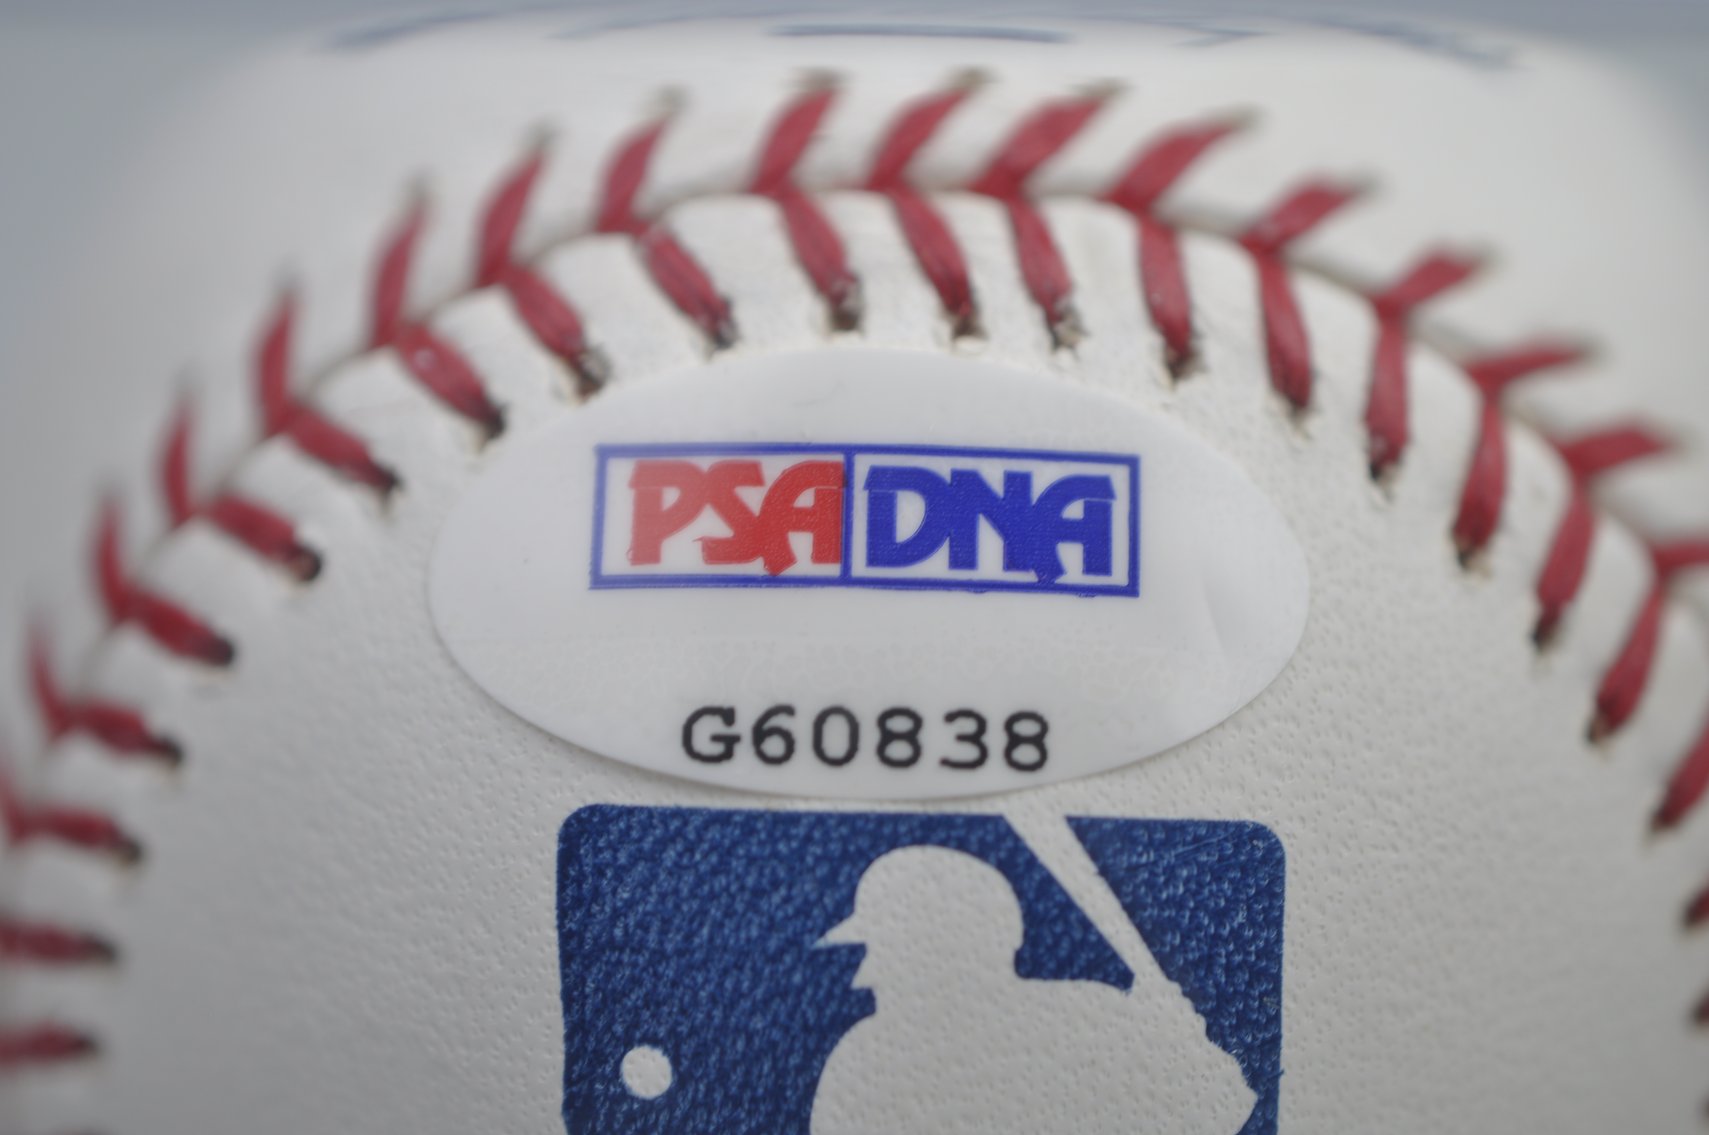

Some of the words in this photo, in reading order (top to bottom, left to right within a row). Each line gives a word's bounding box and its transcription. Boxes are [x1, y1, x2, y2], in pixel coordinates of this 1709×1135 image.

[626, 459, 845, 576] PSA
[863, 464, 1117, 583] DNA
[681, 703, 1050, 774] G60838
